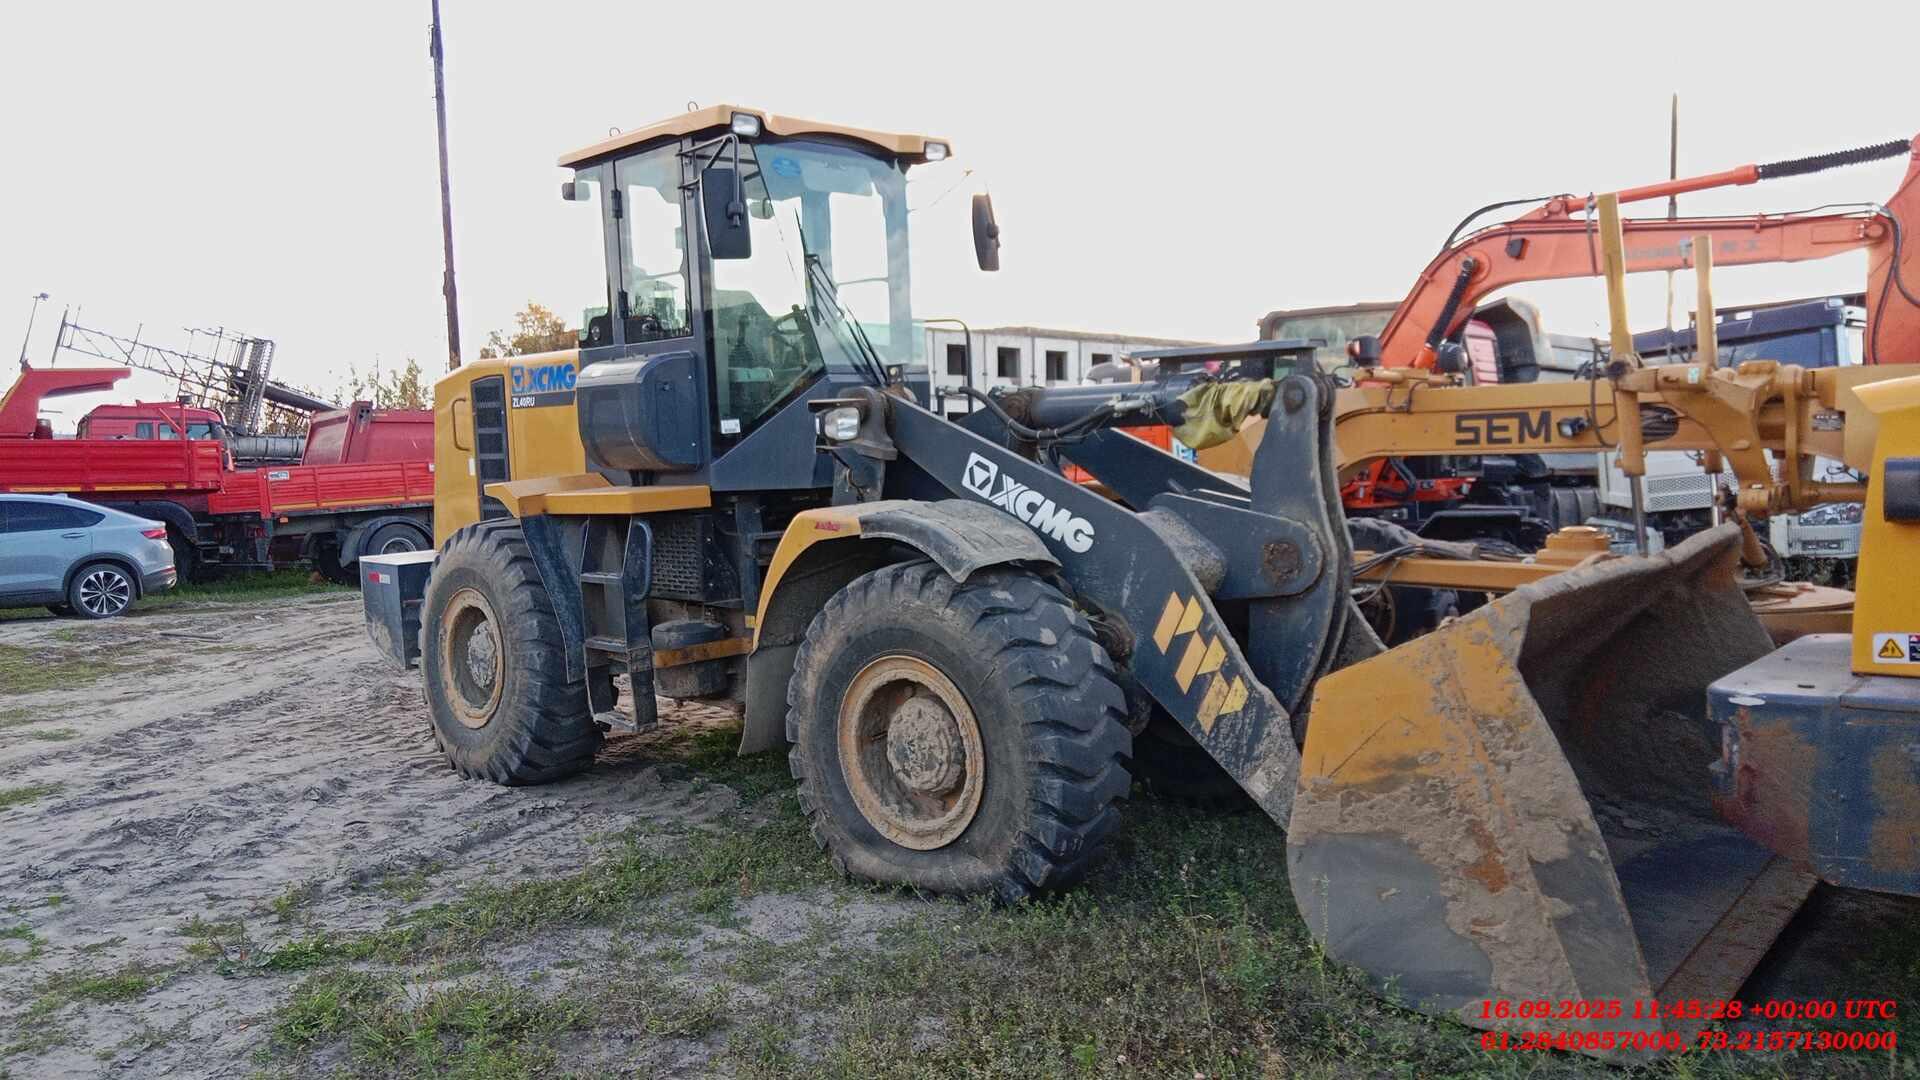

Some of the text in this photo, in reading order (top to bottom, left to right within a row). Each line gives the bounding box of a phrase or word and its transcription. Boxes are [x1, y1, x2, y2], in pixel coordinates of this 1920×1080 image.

[527, 363, 577, 392] XCMG
[1455, 411, 1551, 445] SEM
[988, 474, 1095, 553] XCMG
